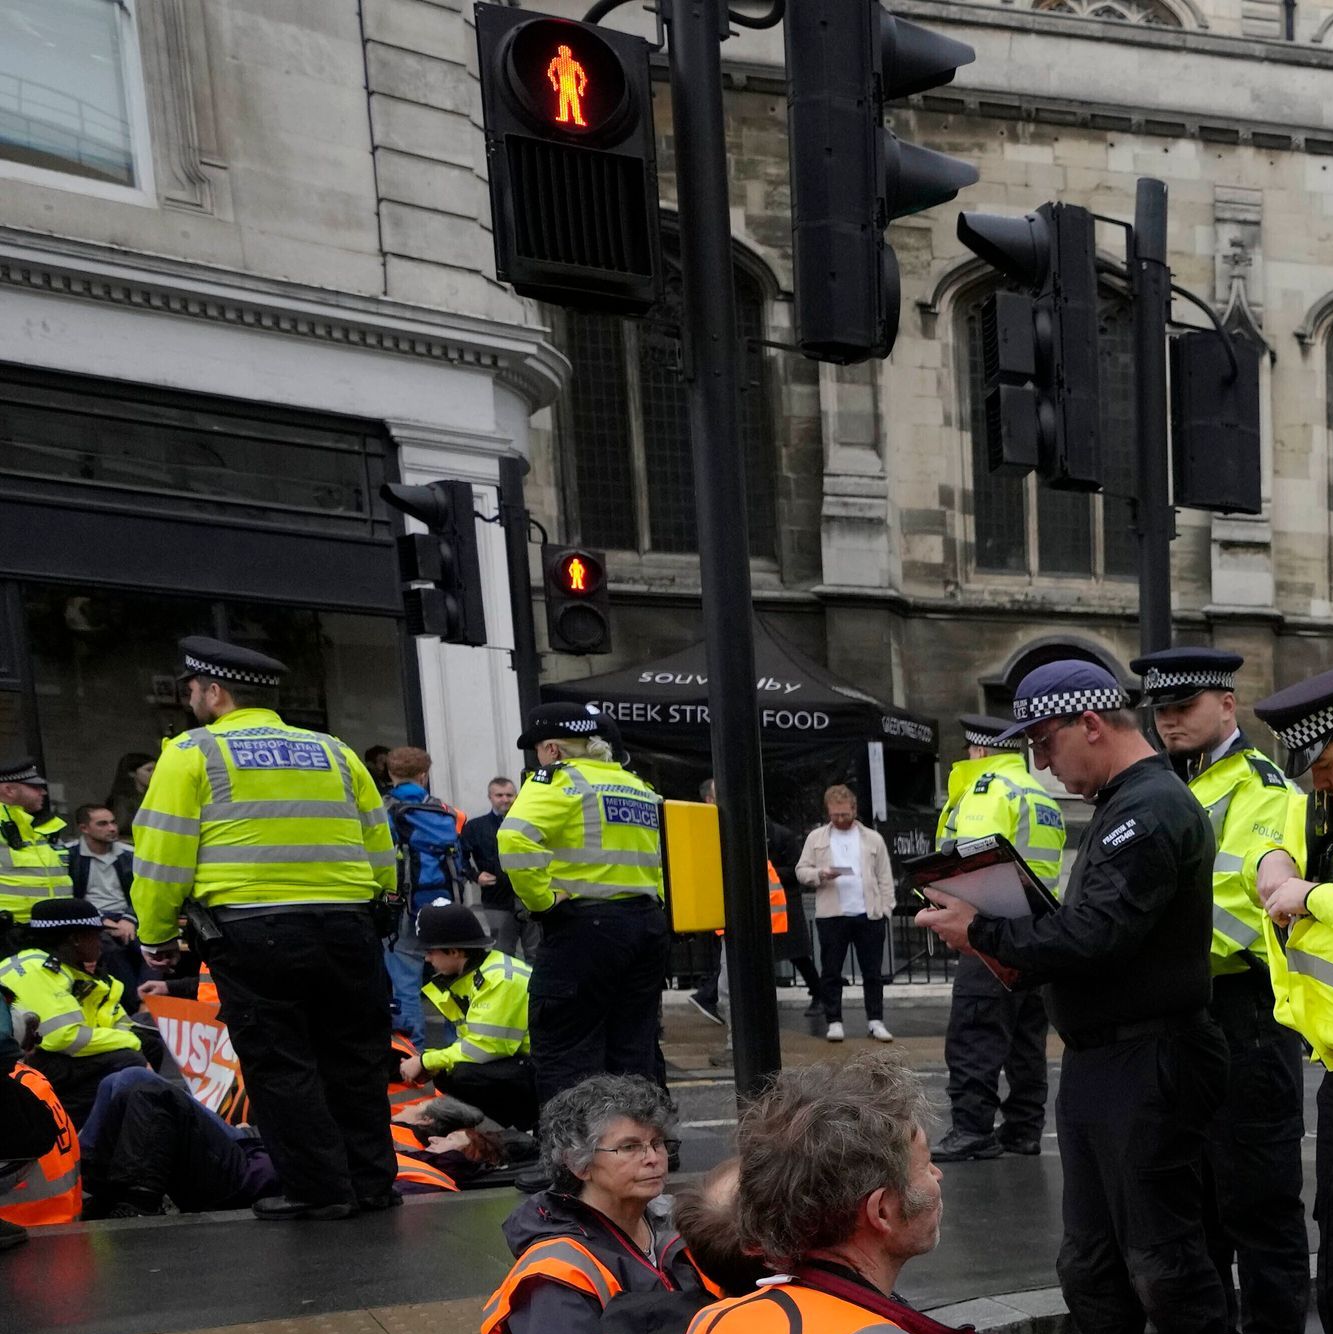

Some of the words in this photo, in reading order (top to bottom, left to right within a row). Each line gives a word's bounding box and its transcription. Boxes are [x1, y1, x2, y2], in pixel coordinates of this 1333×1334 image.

[669, 704, 711, 723] STR
[763, 710, 829, 729] FOOD
[236, 750, 328, 766] POLICE
[608, 806, 658, 827] POLICE
[1252, 823, 1284, 844] POLICE
